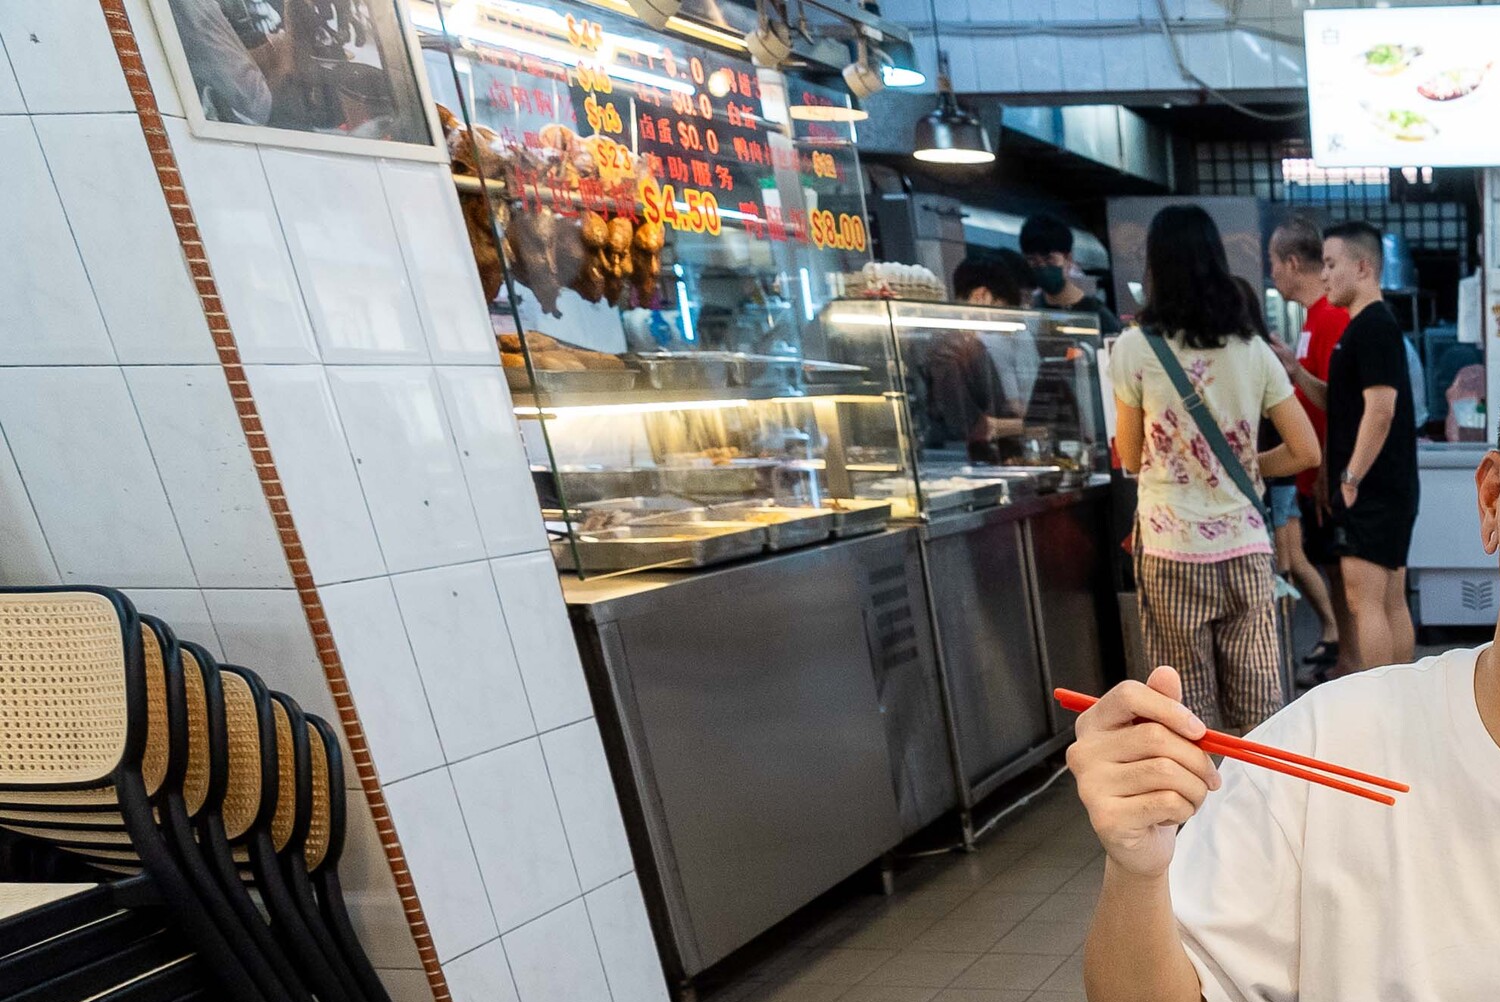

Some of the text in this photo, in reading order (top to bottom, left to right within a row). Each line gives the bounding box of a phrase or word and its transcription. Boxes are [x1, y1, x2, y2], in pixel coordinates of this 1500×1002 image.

[646, 151, 734, 191] 自助服务
[643, 184, 721, 236] $4.50
[811, 209, 865, 250] $8.00
